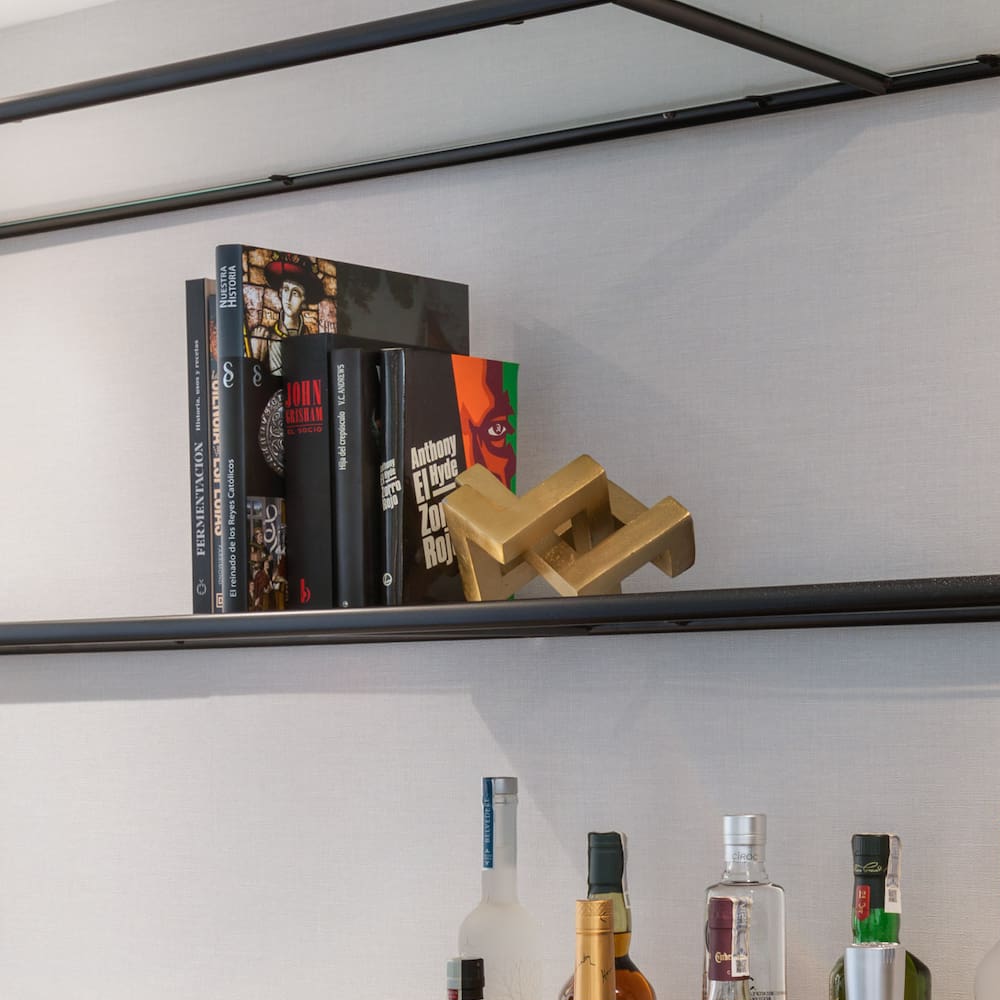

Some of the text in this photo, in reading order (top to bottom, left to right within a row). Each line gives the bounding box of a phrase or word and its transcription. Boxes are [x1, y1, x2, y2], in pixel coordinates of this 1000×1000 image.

[219, 265, 228, 309] NUESTRA
[227, 265, 237, 308] HISTORIA
[285, 379, 322, 408] JOHN
[286, 407, 323, 424] GRISHAM
[298, 426, 322, 434] SOCIO
[337, 411, 348, 446] crepúsculo
[337, 446, 346, 457] del
[338, 457, 348, 471] Hija
[411, 434, 457, 470] Anthony
[412, 458, 459, 505] El Hyde
[227, 458, 238, 598] El reinado de los Reyes Católicos
[418, 502, 447, 537] Zor
[422, 527, 457, 570] Roj
